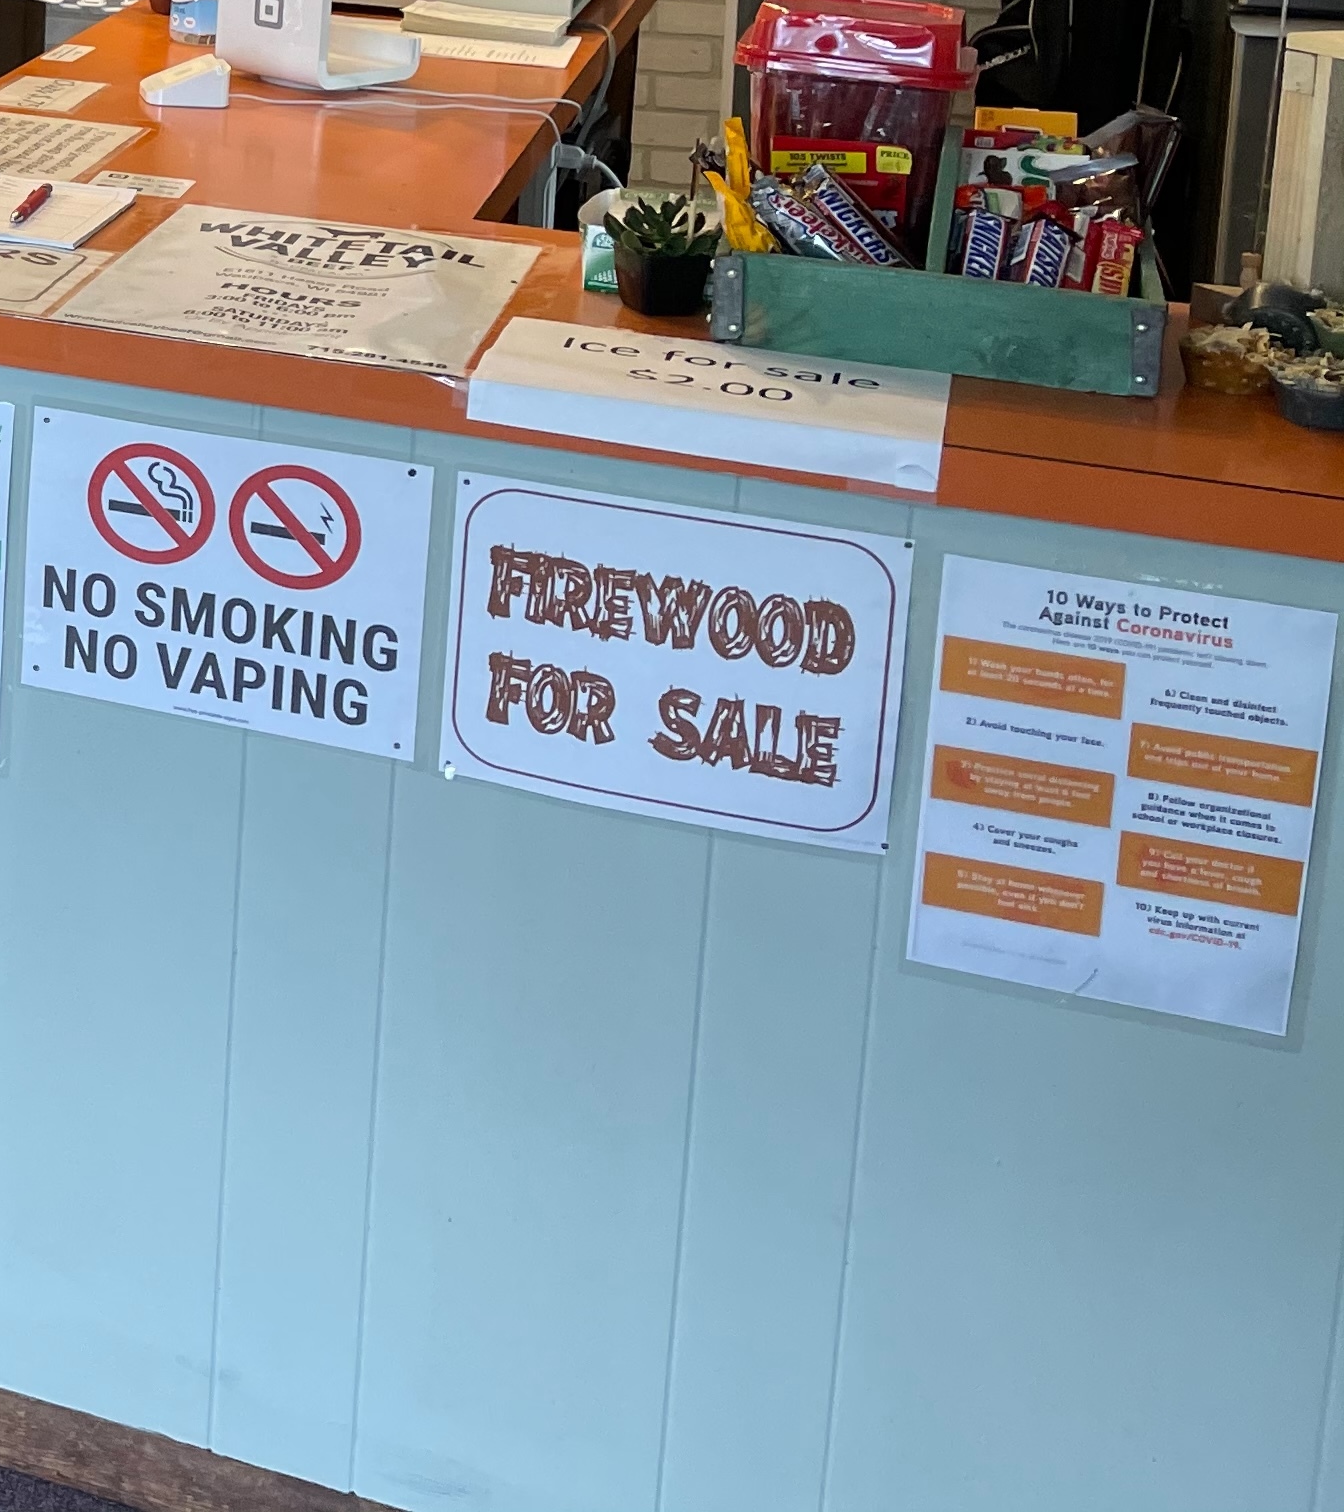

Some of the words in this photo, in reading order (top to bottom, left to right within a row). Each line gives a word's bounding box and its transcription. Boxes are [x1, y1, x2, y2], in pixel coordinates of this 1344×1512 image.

[789, 152, 807, 161] 105
[810, 152, 847, 161] TWISTS
[880, 150, 911, 160] PRICE
[199, 221, 486, 269] WHITETAIL
[228, 234, 440, 270] VALLEY
[286, 257, 355, 271] BEEF
[219, 282, 363, 308] HOURS
[242, 293, 327, 312] FRIDAYS
[211, 305, 330, 328] SATURDAYS
[251, 300, 272, 309] to
[322, 313, 357, 321] pm
[231, 314, 251, 324] to
[315, 327, 349, 335] am
[562, 335, 642, 358] Ice
[662, 349, 747, 370] for
[762, 365, 883, 390] sale
[625, 367, 795, 402] $2.00
[40, 564, 118, 620] NO
[133, 580, 400, 675] SMOKING
[487, 541, 857, 678] FIREWOOD
[1047, 589, 1069, 605] 10
[1076, 593, 1126, 616] Ways
[1134, 603, 1152, 618] to
[1158, 605, 1229, 629] Protect
[1038, 606, 1110, 630] Against
[1116, 618, 1234, 649] Coronavirus
[62, 625, 138, 683] NO
[155, 643, 372, 728] VAPING
[1179, 690, 1208, 703] Clean
[1211, 697, 1230, 706] and
[484, 650, 618, 746] FOR
[647, 688, 844, 790] SALE
[1150, 697, 1203, 715] frequently
[1204, 706, 1246, 720] touched
[1247, 713, 1289, 727] objects.
[979, 719, 1007, 731] Avoid
[1010, 724, 1052, 740] touching
[1055, 732, 1077, 743] your
[1132, 812, 1165, 823] school
[1167, 817, 1178, 826] or
[1140, 803, 1186, 817] guidance
[1188, 810, 1217, 822] when
[1229, 817, 1262, 830] comes
[1162, 794, 1196, 808] Follow
[1199, 802, 1272, 821] organizational
[987, 825, 1016, 837] Cover
[1018, 831, 1041, 841] your
[1135, 901, 1151, 912] 10)
[1154, 905, 1179, 919] Keep
[1182, 911, 1195, 921] up
[1198, 912, 1220, 925] with
[1223, 918, 1260, 932] current
[1146, 916, 1173, 927] virus
[1175, 919, 1233, 938] information
[1235, 932, 1246, 940] at
